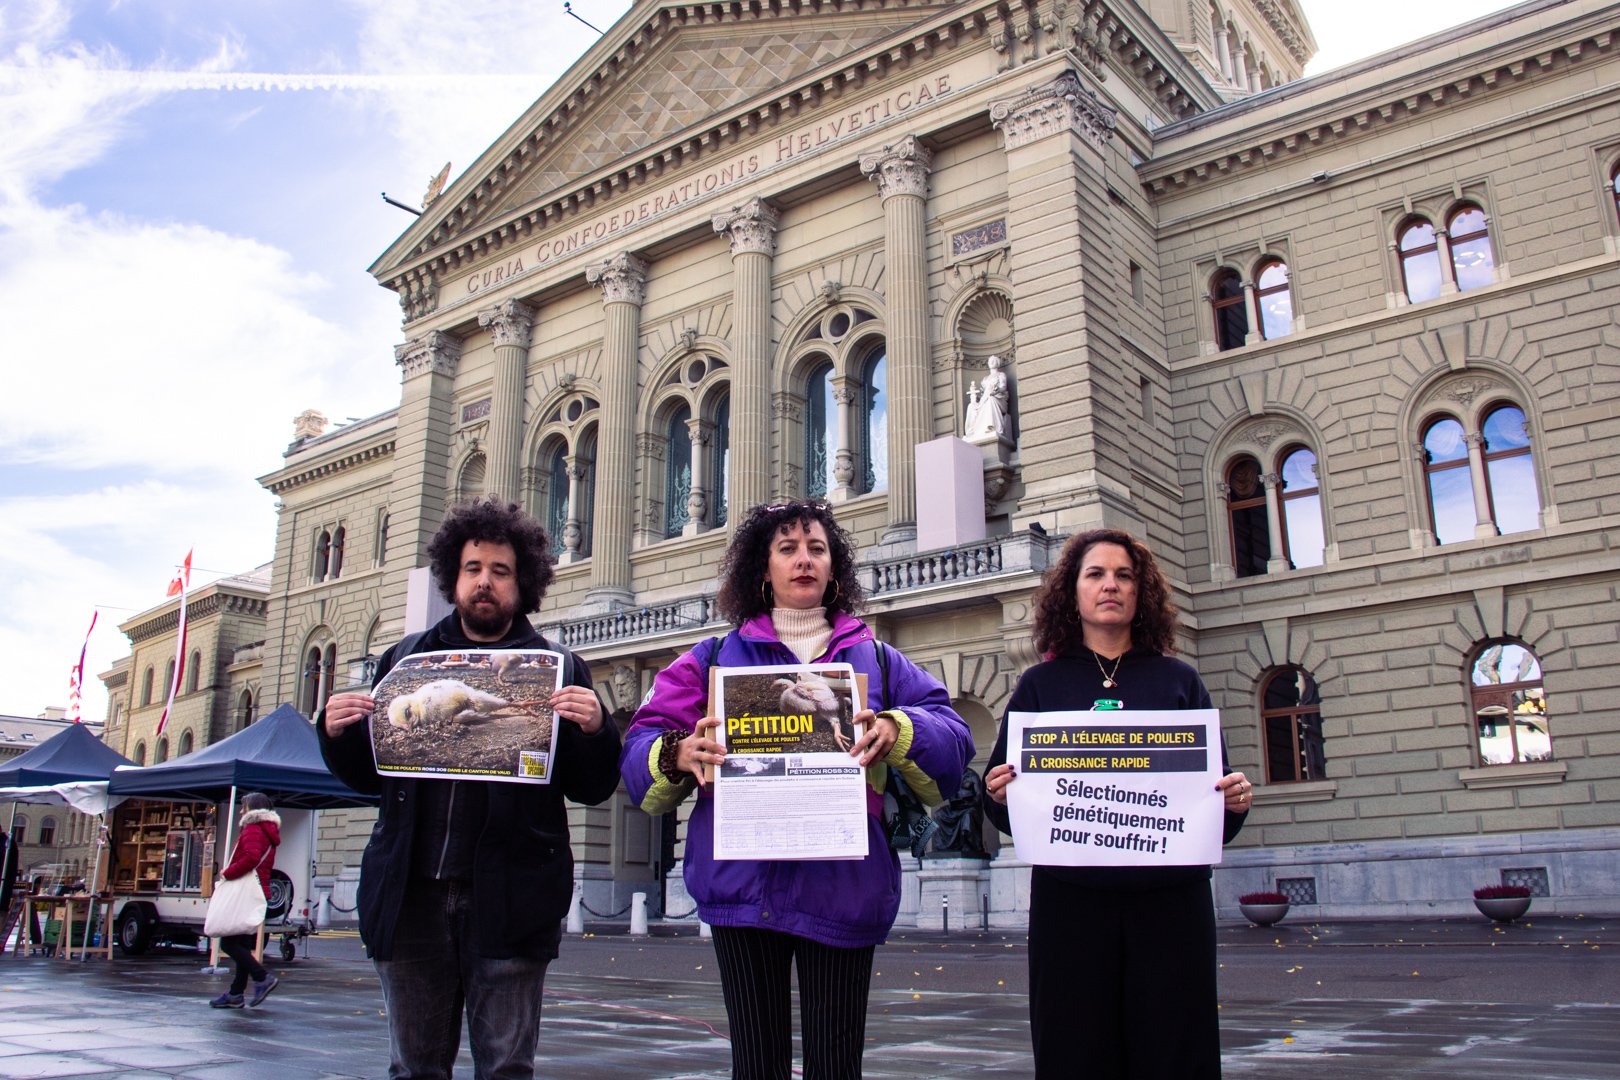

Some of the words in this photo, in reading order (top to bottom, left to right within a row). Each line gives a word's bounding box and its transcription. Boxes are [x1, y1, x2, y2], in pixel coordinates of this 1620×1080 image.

[467, 258, 524, 294] CURIA
[537, 154, 758, 263] CONFOEDERATIONIS
[775, 74, 952, 163] HELVETICAE
[727, 712, 814, 736] PÉTITION
[1029, 733, 1058, 745] STOP
[1060, 731, 1069, 744] À
[1072, 730, 1126, 745] L'ÉLEVAGE
[1129, 732, 1144, 744] DE
[1147, 732, 1195, 744] POULETS
[789, 767, 821, 775] PÉTITION
[1029, 755, 1037, 768] À
[1040, 757, 1108, 769] CROISSANCE
[1111, 757, 1150, 768] RAPIDE
[1055, 778, 1168, 808] Sélectionnés
[1053, 802, 1185, 833] génétiquement
[1050, 827, 1091, 844] pour
[1094, 833, 1159, 853] souffrir
